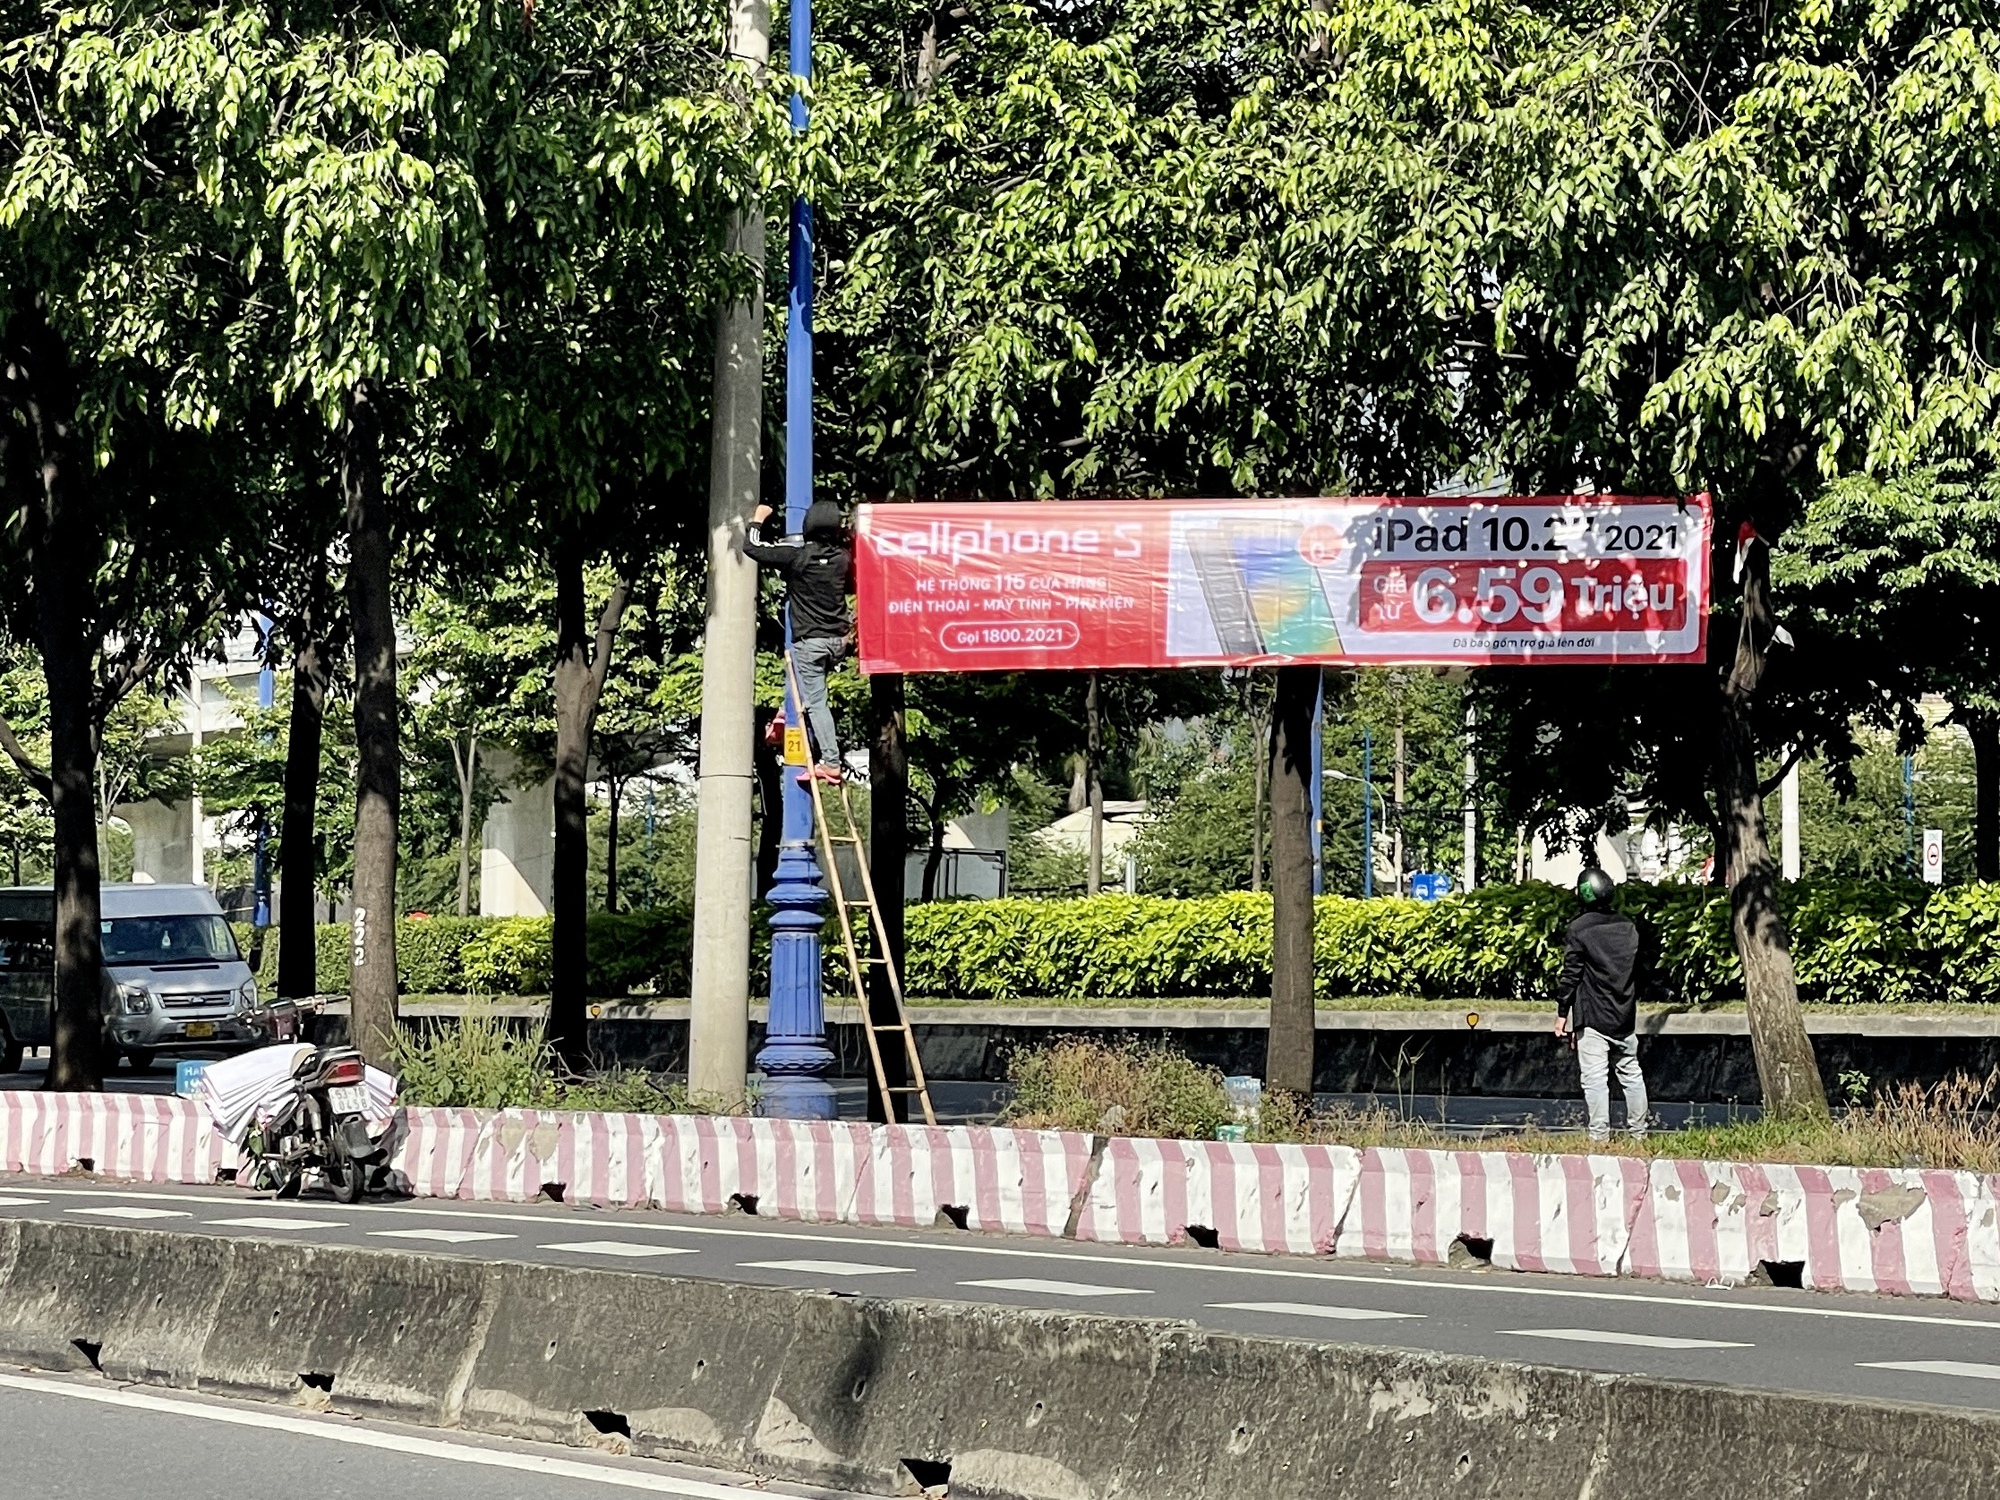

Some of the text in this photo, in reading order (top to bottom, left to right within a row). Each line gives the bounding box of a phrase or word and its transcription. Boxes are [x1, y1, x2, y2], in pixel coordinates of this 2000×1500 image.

[1374, 516, 1468, 552] iPad
[1605, 524, 1677, 551] 2021
[916, 577, 936, 594] HỆ
[1413, 566, 1565, 624] 6.59
[888, 598, 923, 616] ĐIỆN
[926, 600, 970, 615] THOẠI
[957, 628, 1063, 646] Gọi 1800.2021
[1469, 637, 1490, 648] bao
[788, 740, 801, 752] 21
[354, 907, 367, 967] 222
